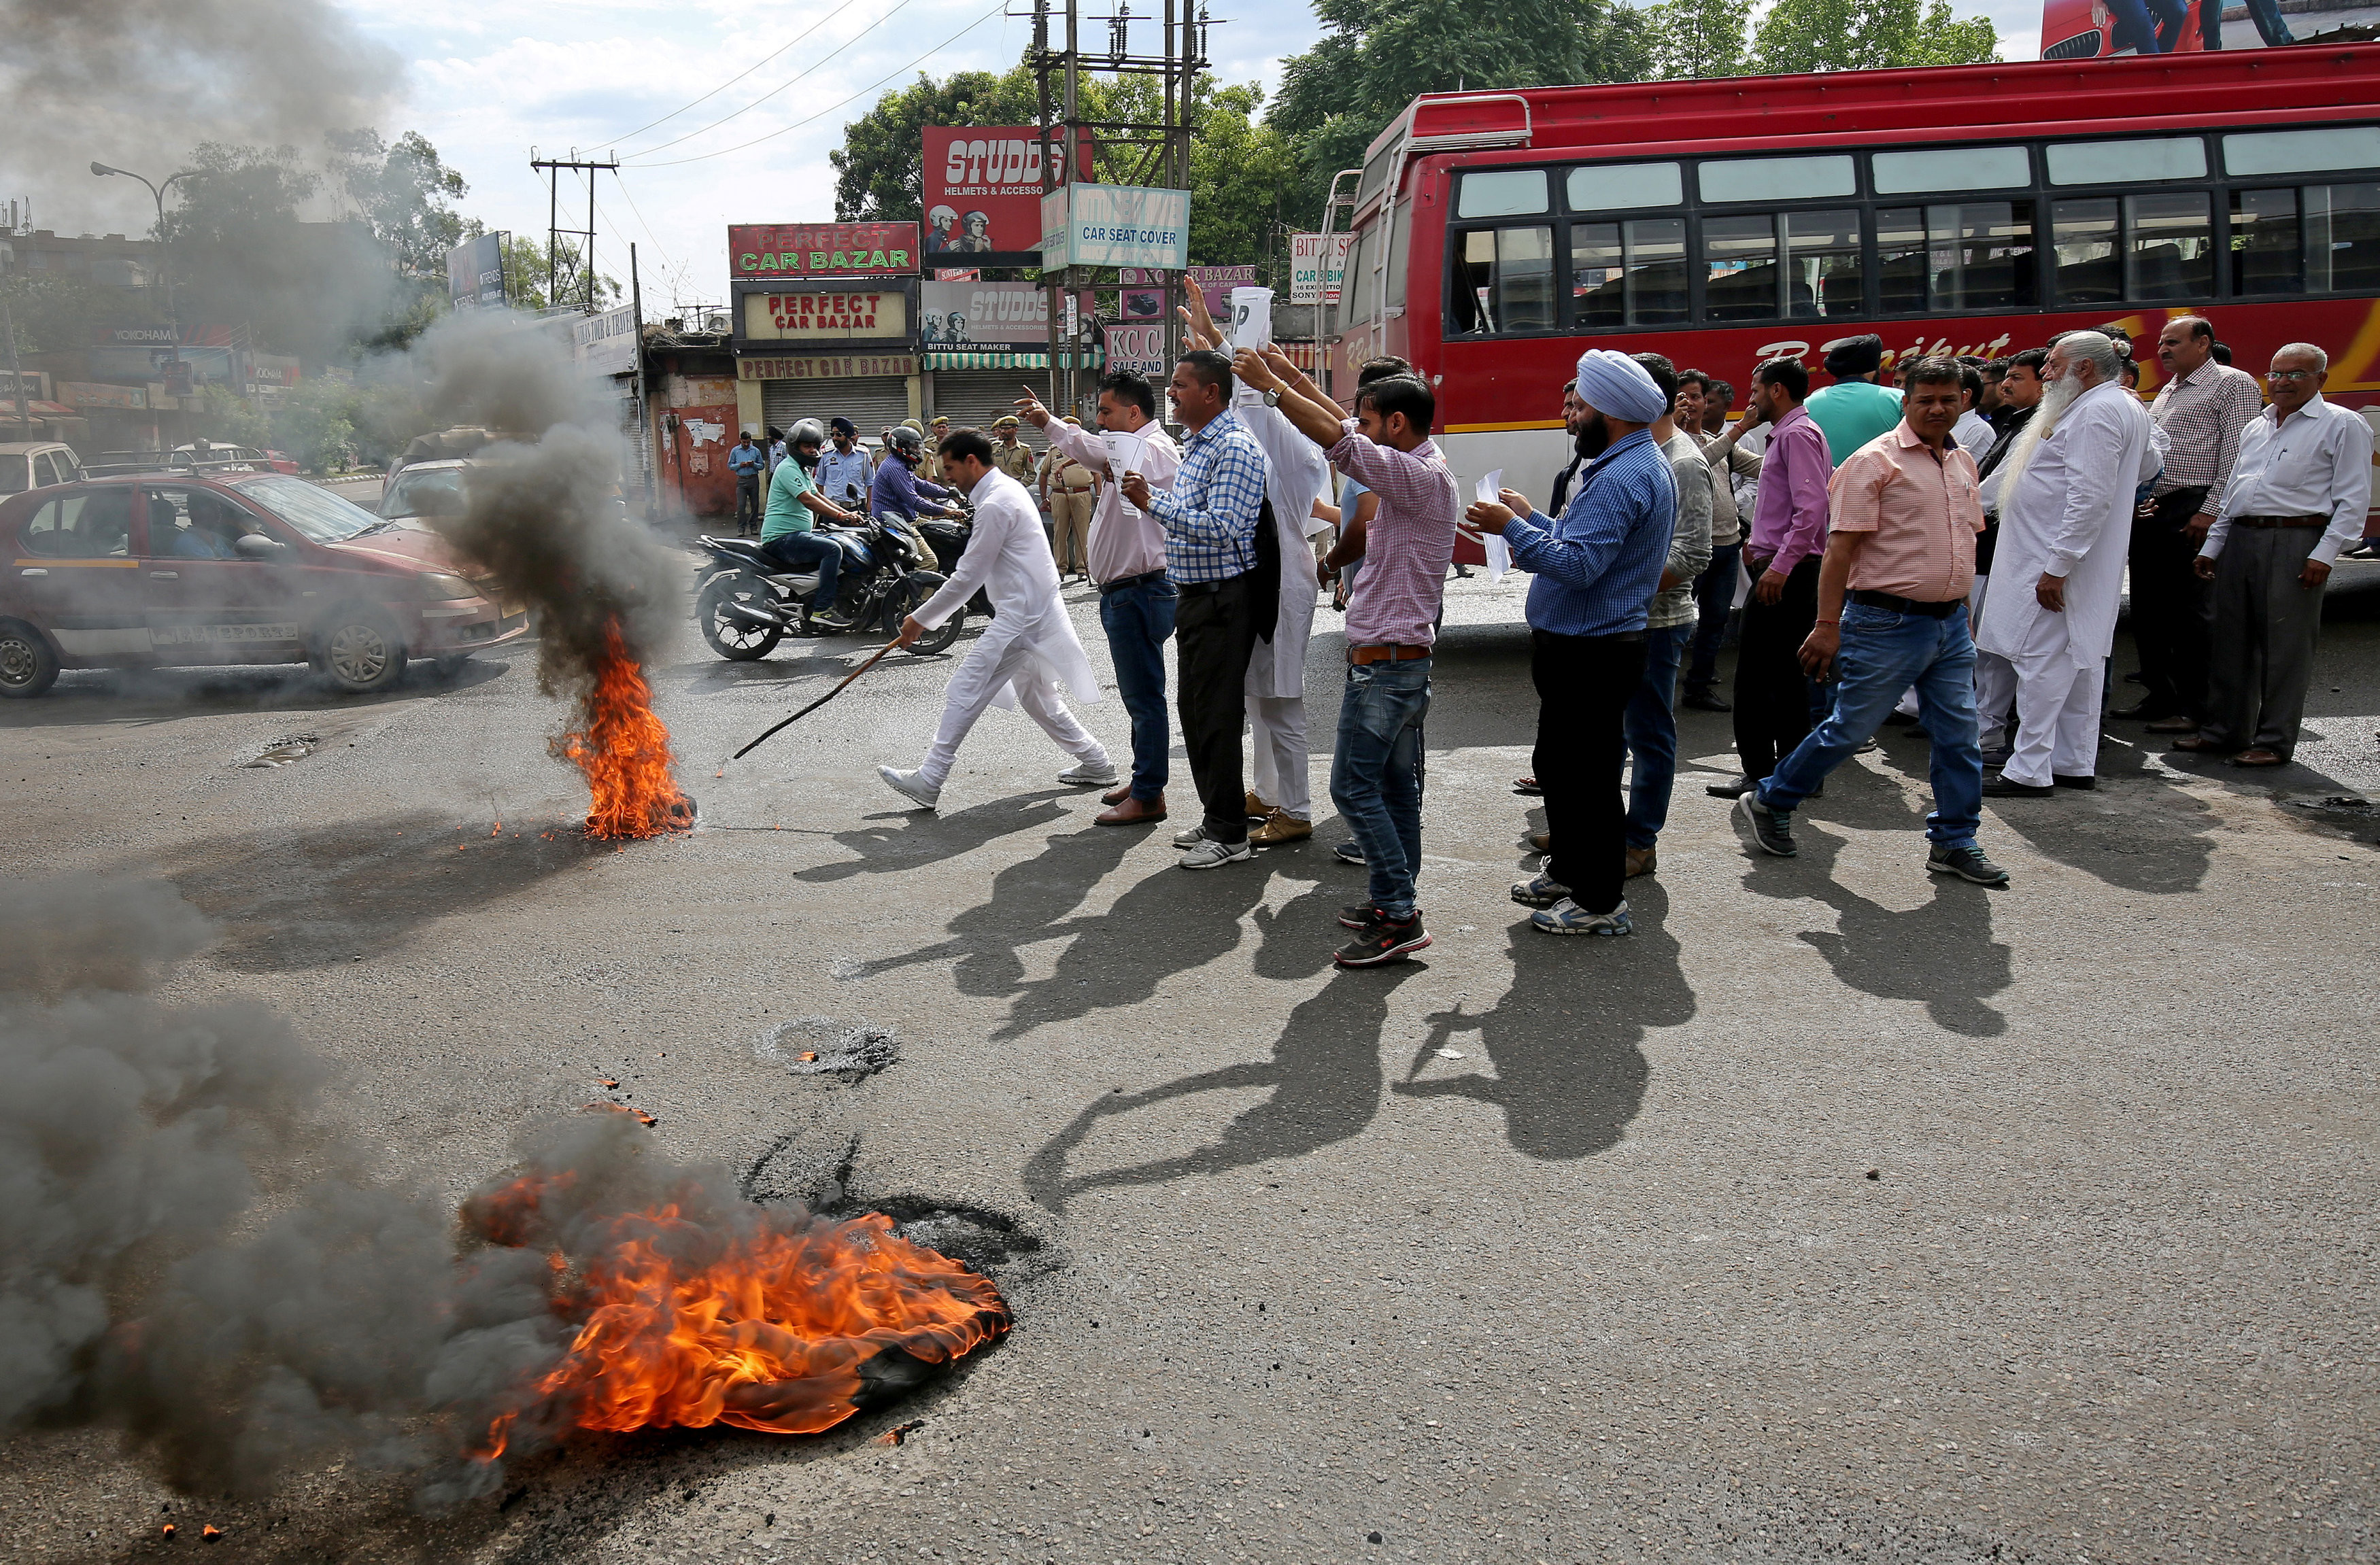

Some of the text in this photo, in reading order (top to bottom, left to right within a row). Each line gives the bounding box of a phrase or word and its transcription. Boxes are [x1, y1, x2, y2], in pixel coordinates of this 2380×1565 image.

[945, 187, 987, 195] HELMETS
[1000, 186, 1043, 194] ACCESSO
[1114, 190, 1144, 224] SEAT
[757, 230, 889, 250] PERFECT
[1083, 226, 1176, 245] CAR SEAT COVER
[739, 250, 910, 271] CAR BAZAR
[1109, 246, 1138, 262] SEAT
[1140, 248, 1177, 264] COVER
[482, 269, 500, 285] TRENDS
[1125, 271, 1136, 280] KC
[1204, 269, 1254, 281] BAZAR
[1296, 270, 1316, 281] CAR
[1327, 270, 1344, 281] BIK
[768, 295, 880, 315] PERFECT
[970, 291, 1048, 322] STUDDS
[591, 319, 605, 341] TOUR
[606, 316, 611, 337] &
[612, 309, 636, 337] TRAVELS
[775, 315, 875, 329] CAR BAZAR
[1110, 330, 1140, 358] KC
[743, 358, 912, 379] PERFECT CAR BAZAR
[1140, 361, 1161, 373] AND
[795, 477, 802, 487] 3
